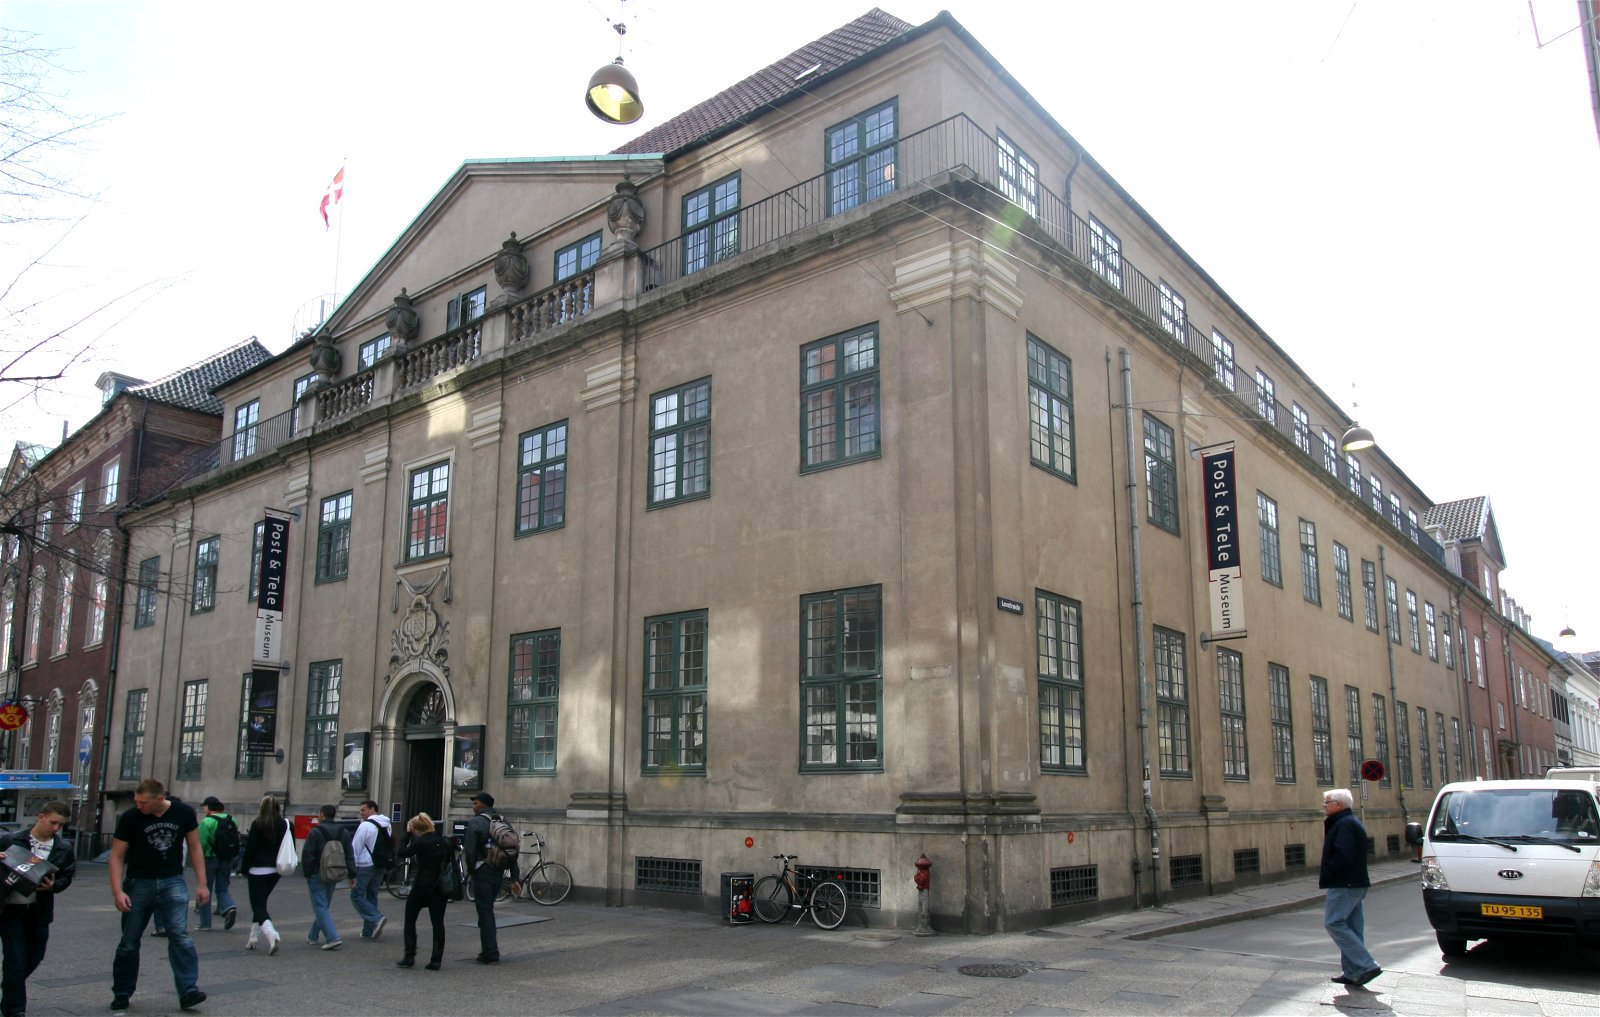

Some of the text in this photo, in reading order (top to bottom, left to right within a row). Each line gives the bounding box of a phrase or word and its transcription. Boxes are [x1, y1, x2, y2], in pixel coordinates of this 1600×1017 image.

[1213, 459, 1232, 629] Post & Tele Museum
[262, 523, 284, 659] Post & Tele Museum
[1501, 870, 1520, 878] KIA
[1520, 908, 1540, 917] 135
